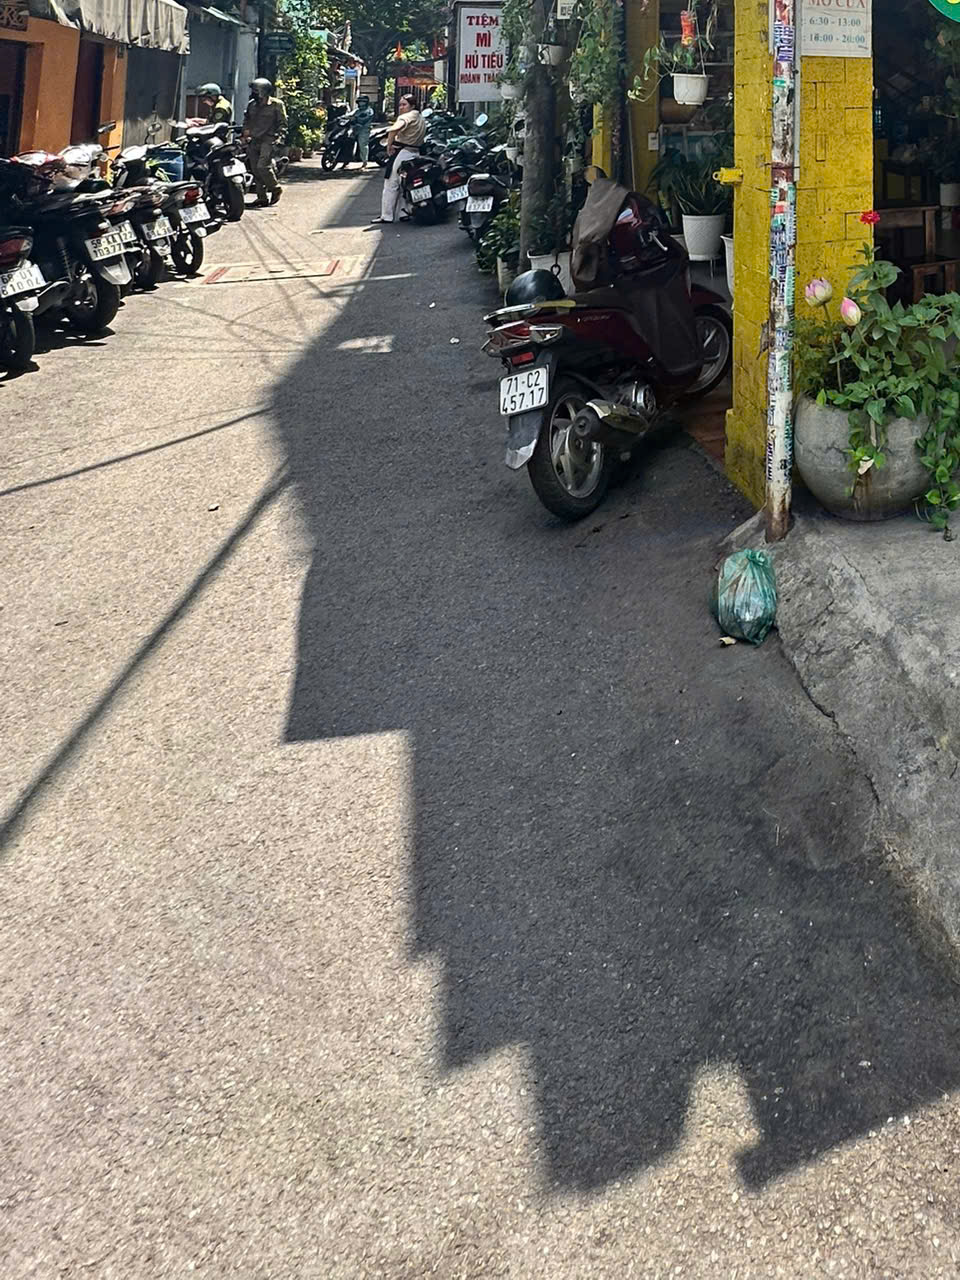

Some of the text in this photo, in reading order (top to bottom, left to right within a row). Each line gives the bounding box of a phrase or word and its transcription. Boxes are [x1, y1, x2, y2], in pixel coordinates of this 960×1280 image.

[466, 13, 500, 28] TIỆM
[809, 17, 829, 25] 6:30
[476, 30, 491, 47] MÌ
[465, 49, 503, 69] HỦ TIẾU
[506, 370, 541, 395] 71-C2
[502, 388, 545, 414] 457.17
